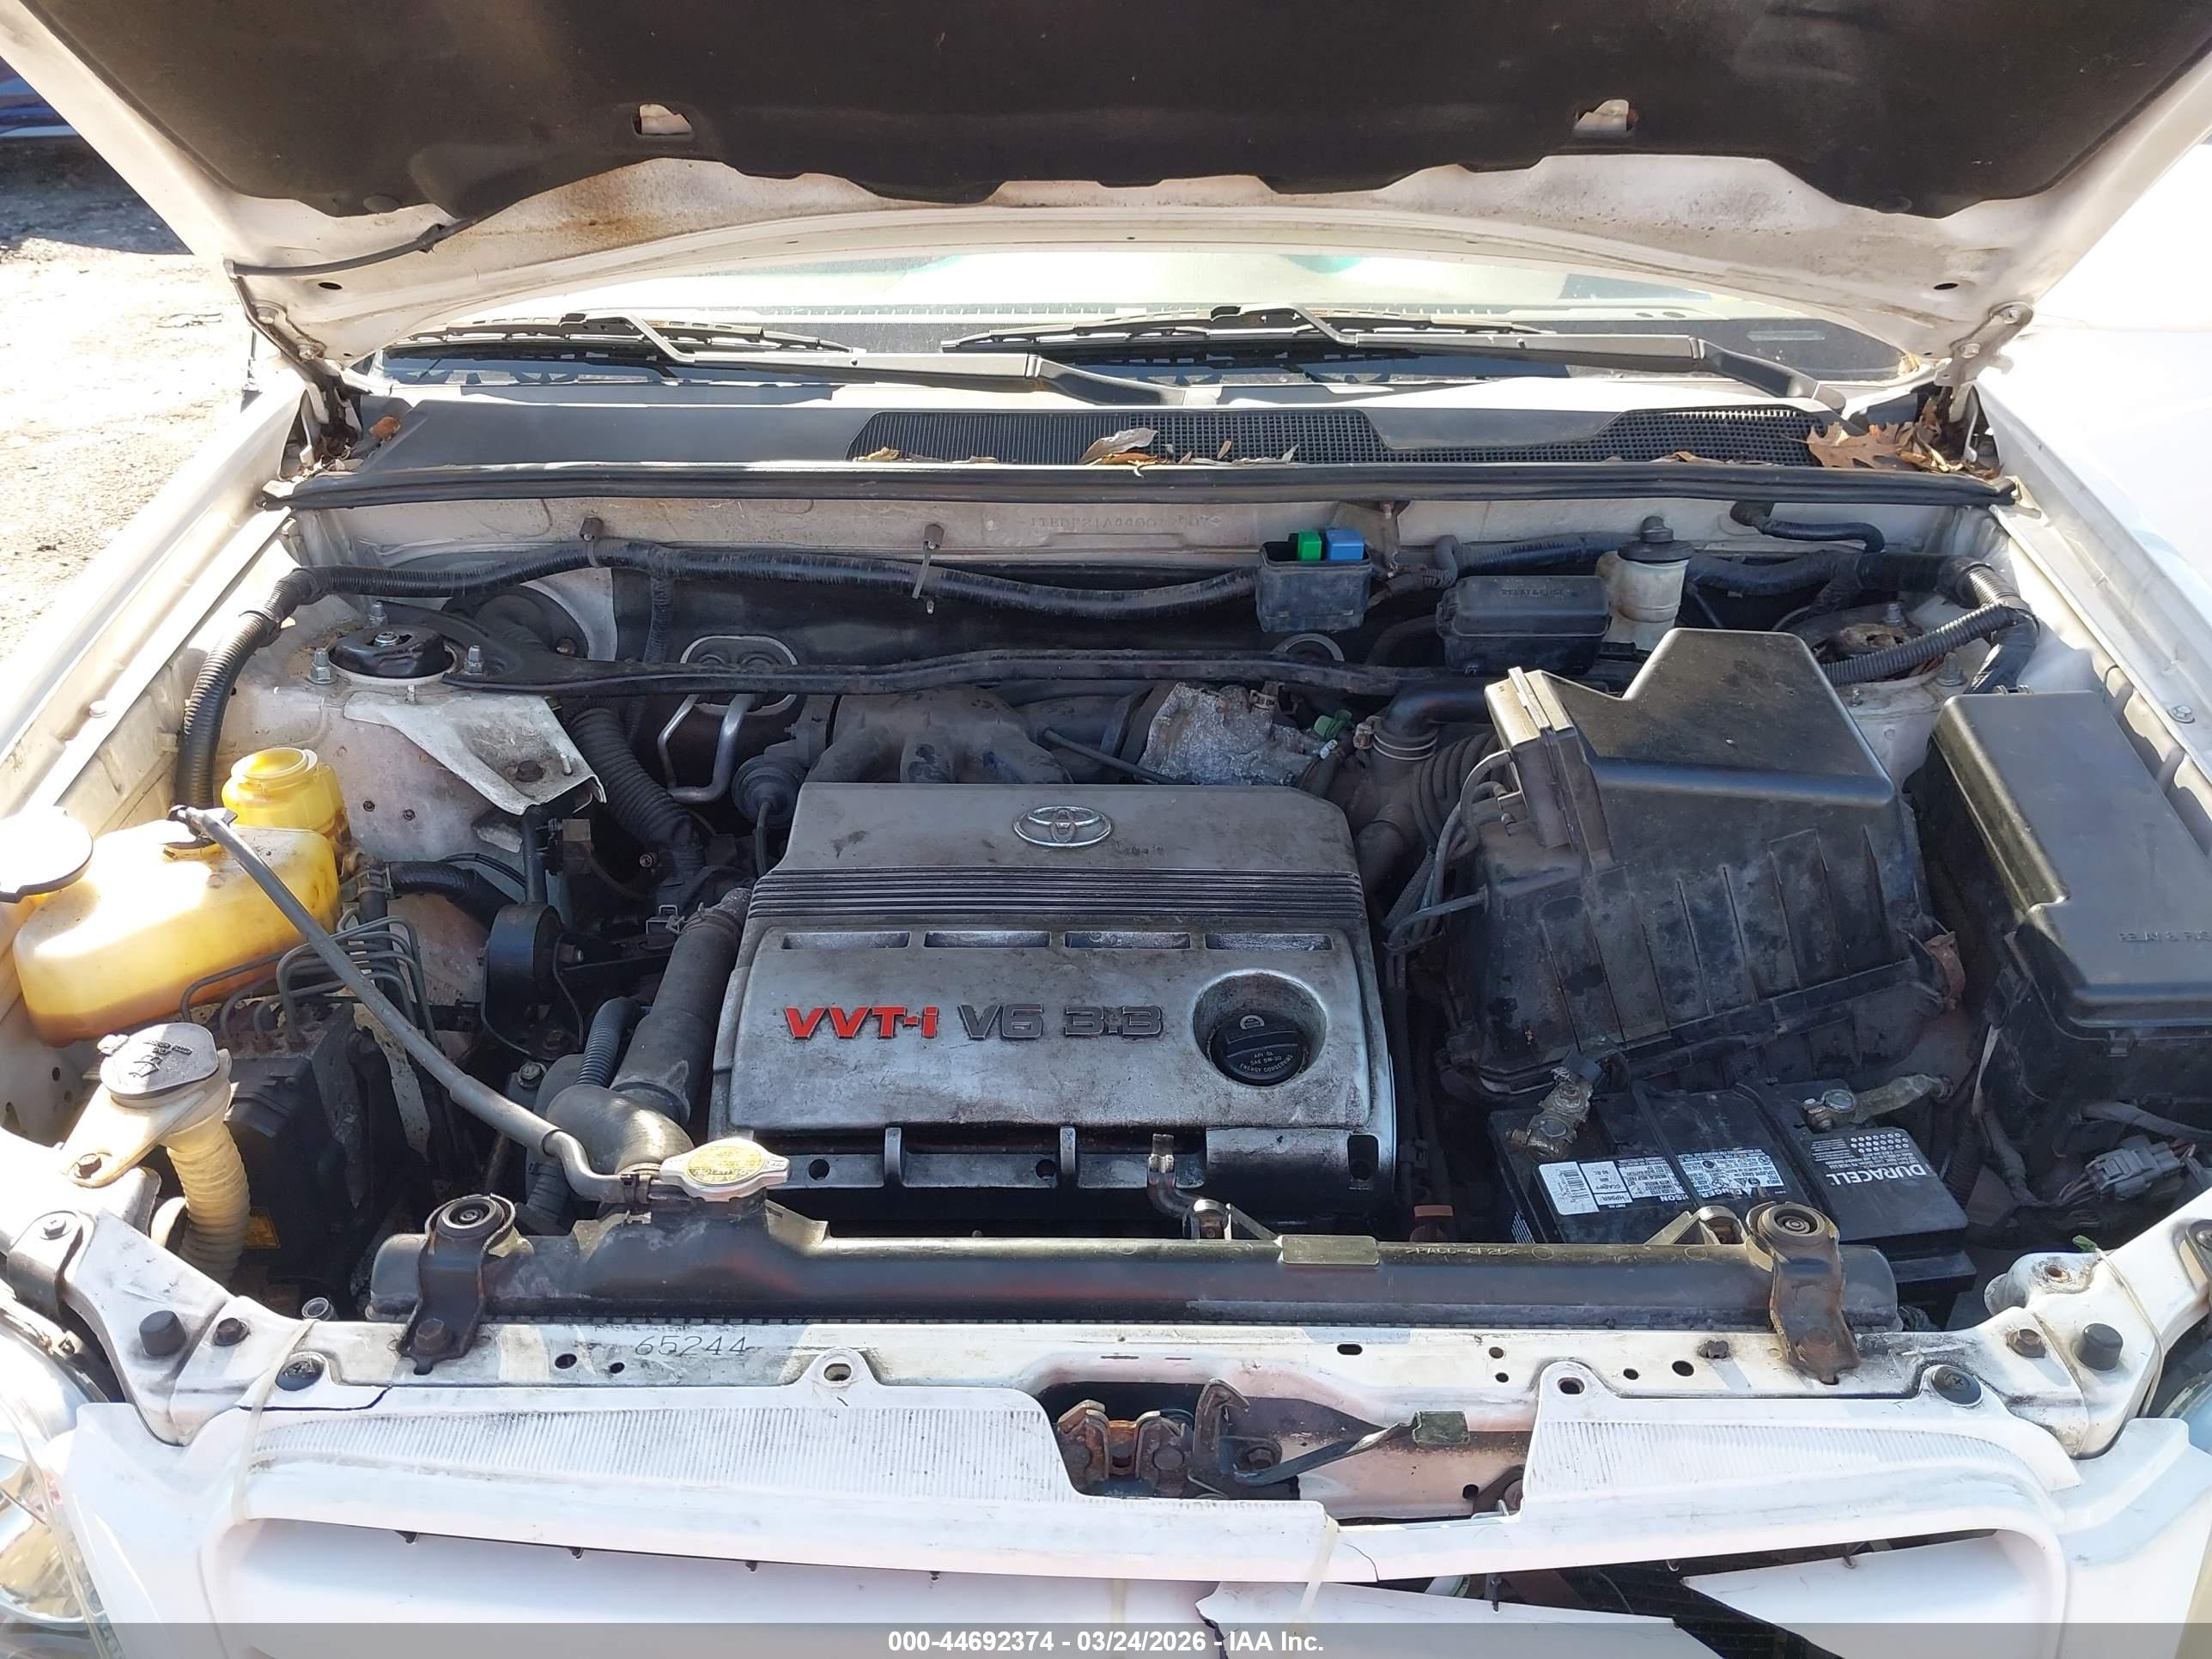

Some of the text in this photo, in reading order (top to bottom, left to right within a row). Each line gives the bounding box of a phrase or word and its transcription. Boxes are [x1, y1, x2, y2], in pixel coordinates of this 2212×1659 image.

[783, 1004, 1164, 1039] VVT-i V6 3.3
[1239, 1063, 1261, 1072] ENERGY
[1826, 1164, 1927, 1186] DURACELL
[635, 1335, 746, 1357] 65244
